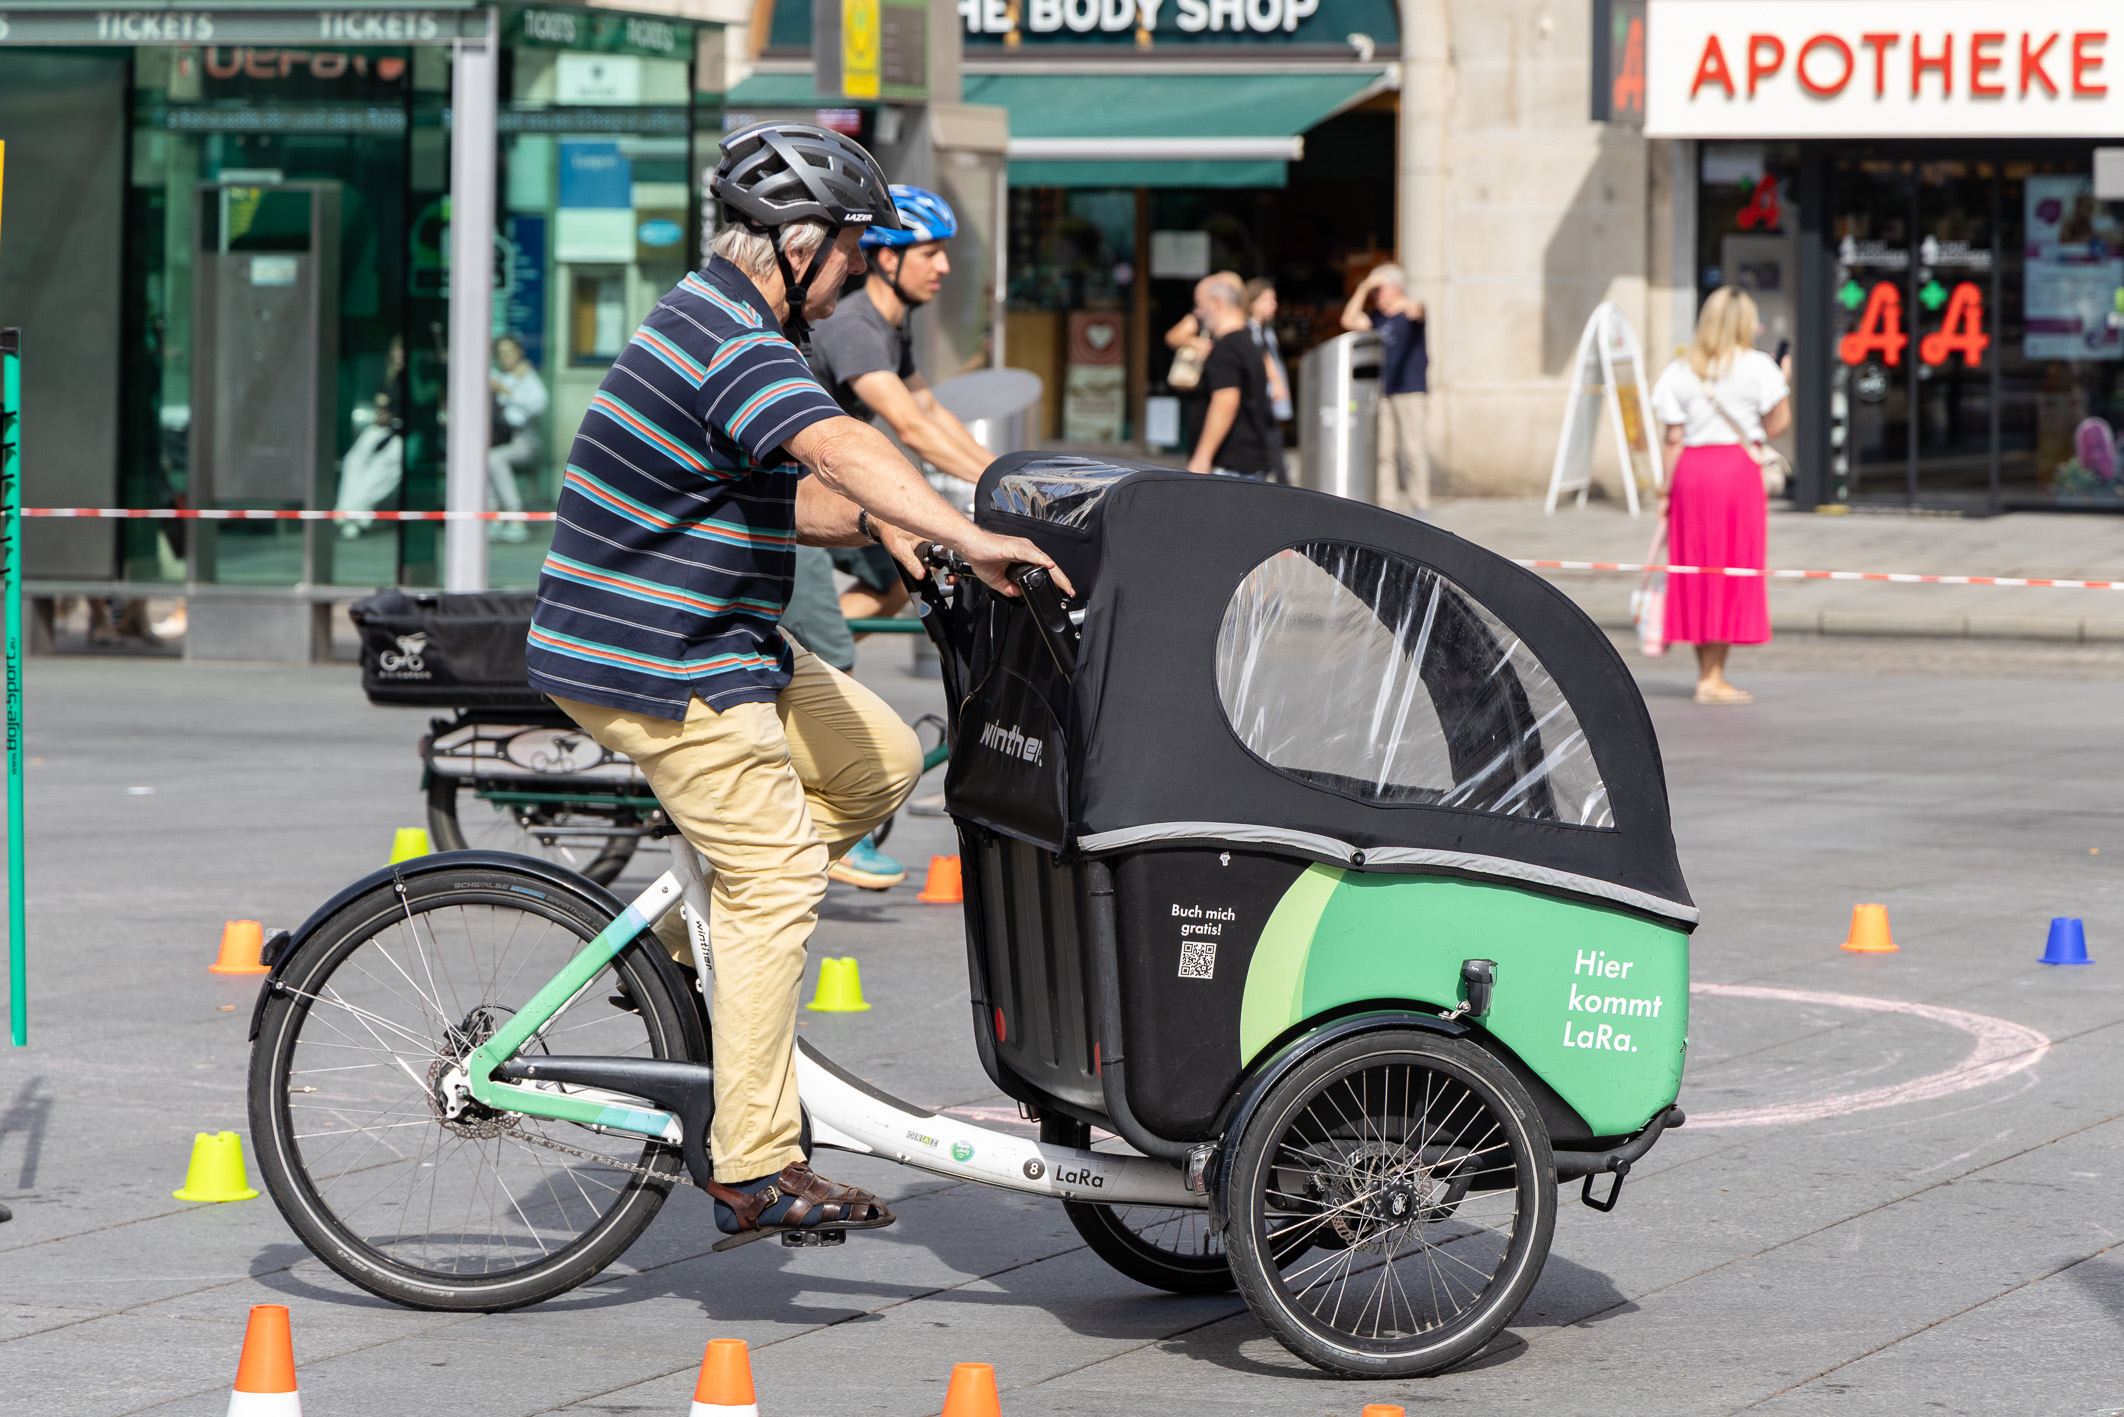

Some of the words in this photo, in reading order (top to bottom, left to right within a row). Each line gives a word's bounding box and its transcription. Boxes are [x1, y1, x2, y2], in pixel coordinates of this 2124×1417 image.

[98, 13, 214, 41] TICKETS
[319, 12, 437, 40] TICKETS
[957, 0, 1015, 33] HE
[1027, 0, 1161, 33] BODY
[1174, 0, 1319, 33] SHOP
[1690, 32, 2108, 97] APOTHEKE
[844, 213, 873, 222] LAZER
[453, 882, 510, 890] SCHWALBE
[546, 895, 591, 923] MARATHON
[1171, 903, 1202, 918] Buch
[1205, 907, 1236, 921] mich
[1181, 922, 1222, 936] gratis!
[696, 920, 713, 971] winther
[1574, 949, 1634, 979] Hier
[1568, 983, 1663, 1018] kommt
[1563, 1021, 1638, 1053] LaRa.
[906, 1130, 939, 1147] GRAZ
[1029, 1162, 1040, 1175] 8
[1055, 1164, 1104, 1188] LaRa
